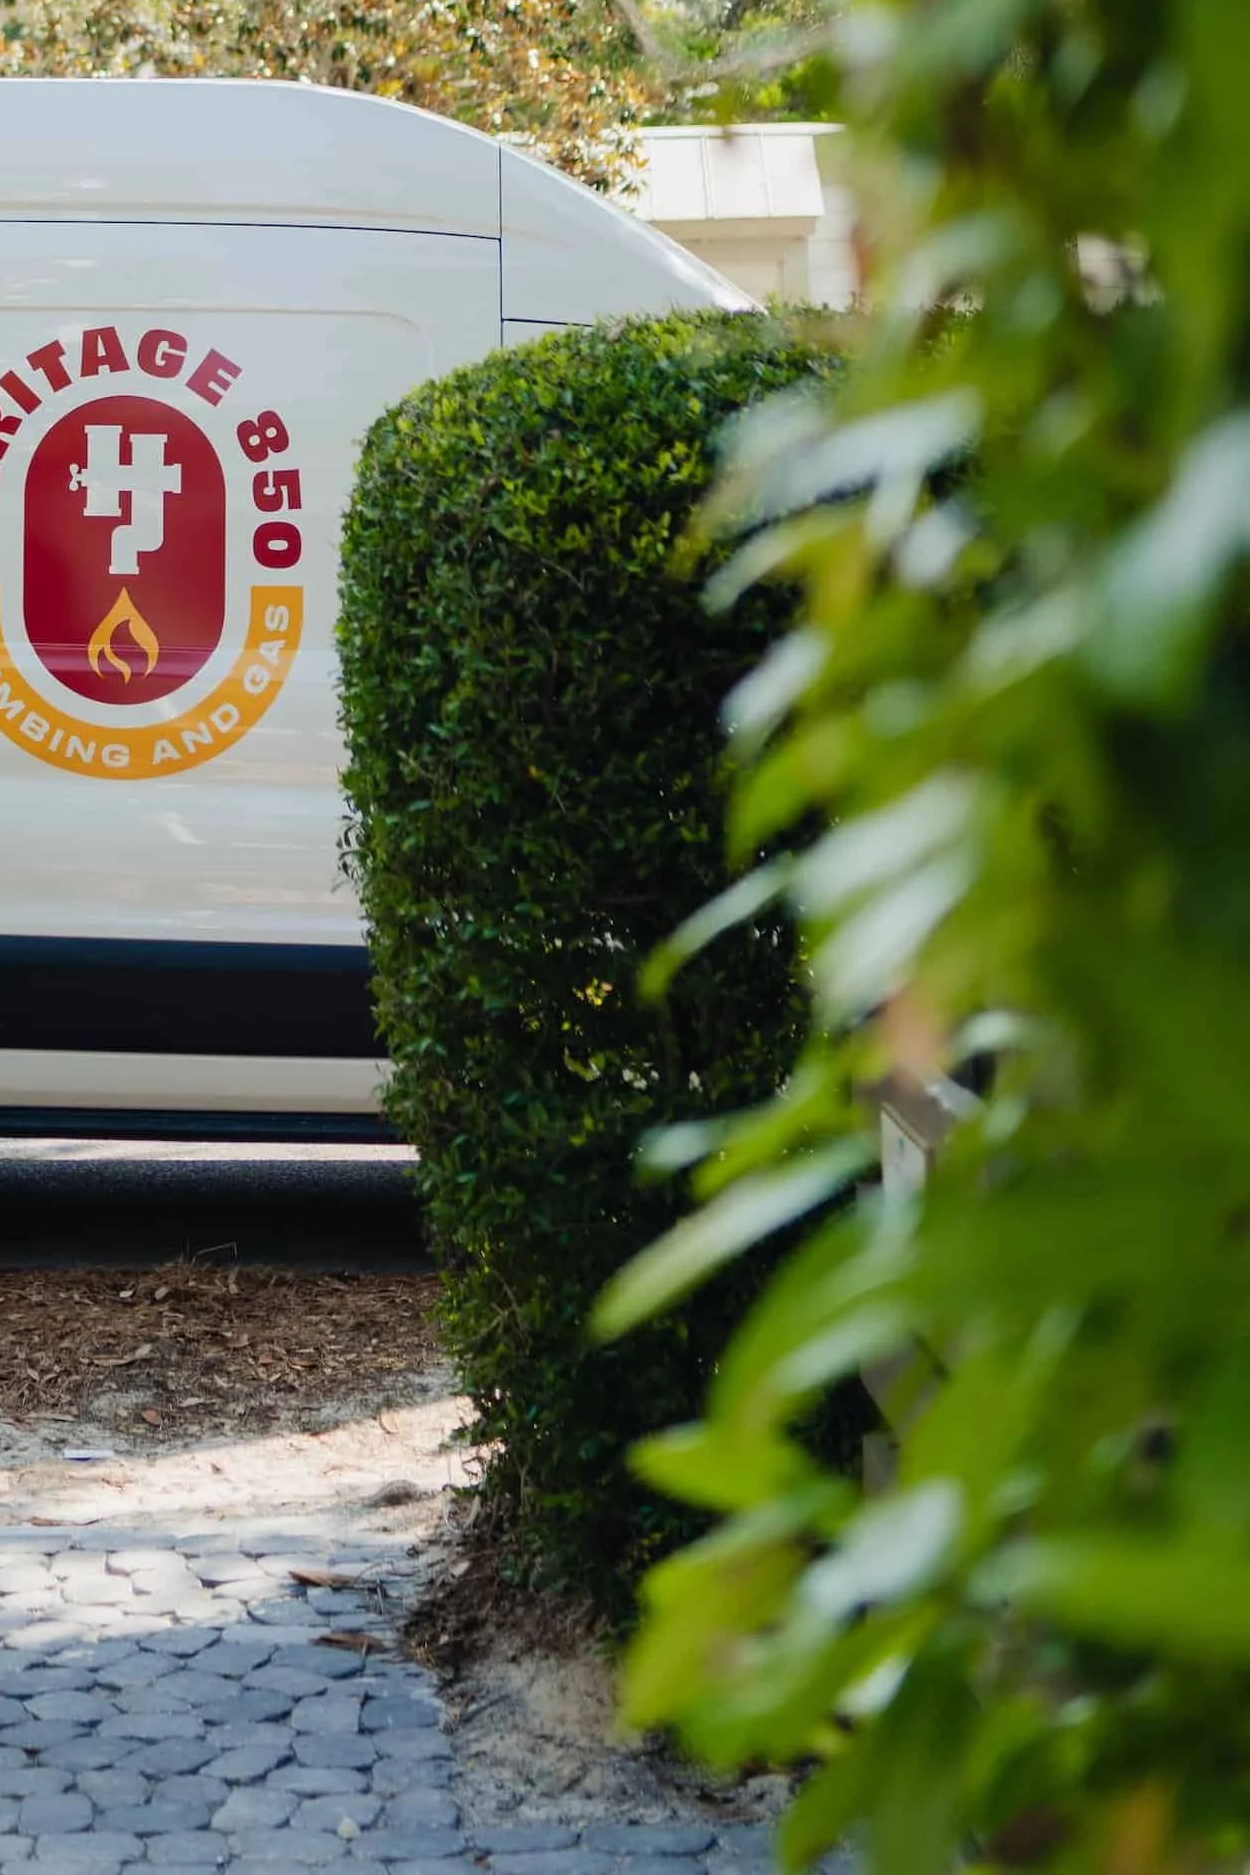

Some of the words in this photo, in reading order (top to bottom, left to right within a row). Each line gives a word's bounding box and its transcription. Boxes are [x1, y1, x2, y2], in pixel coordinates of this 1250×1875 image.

[237, 410, 302, 569] 850
[152, 703, 240, 765] AND
[244, 604, 289, 693] GAS
